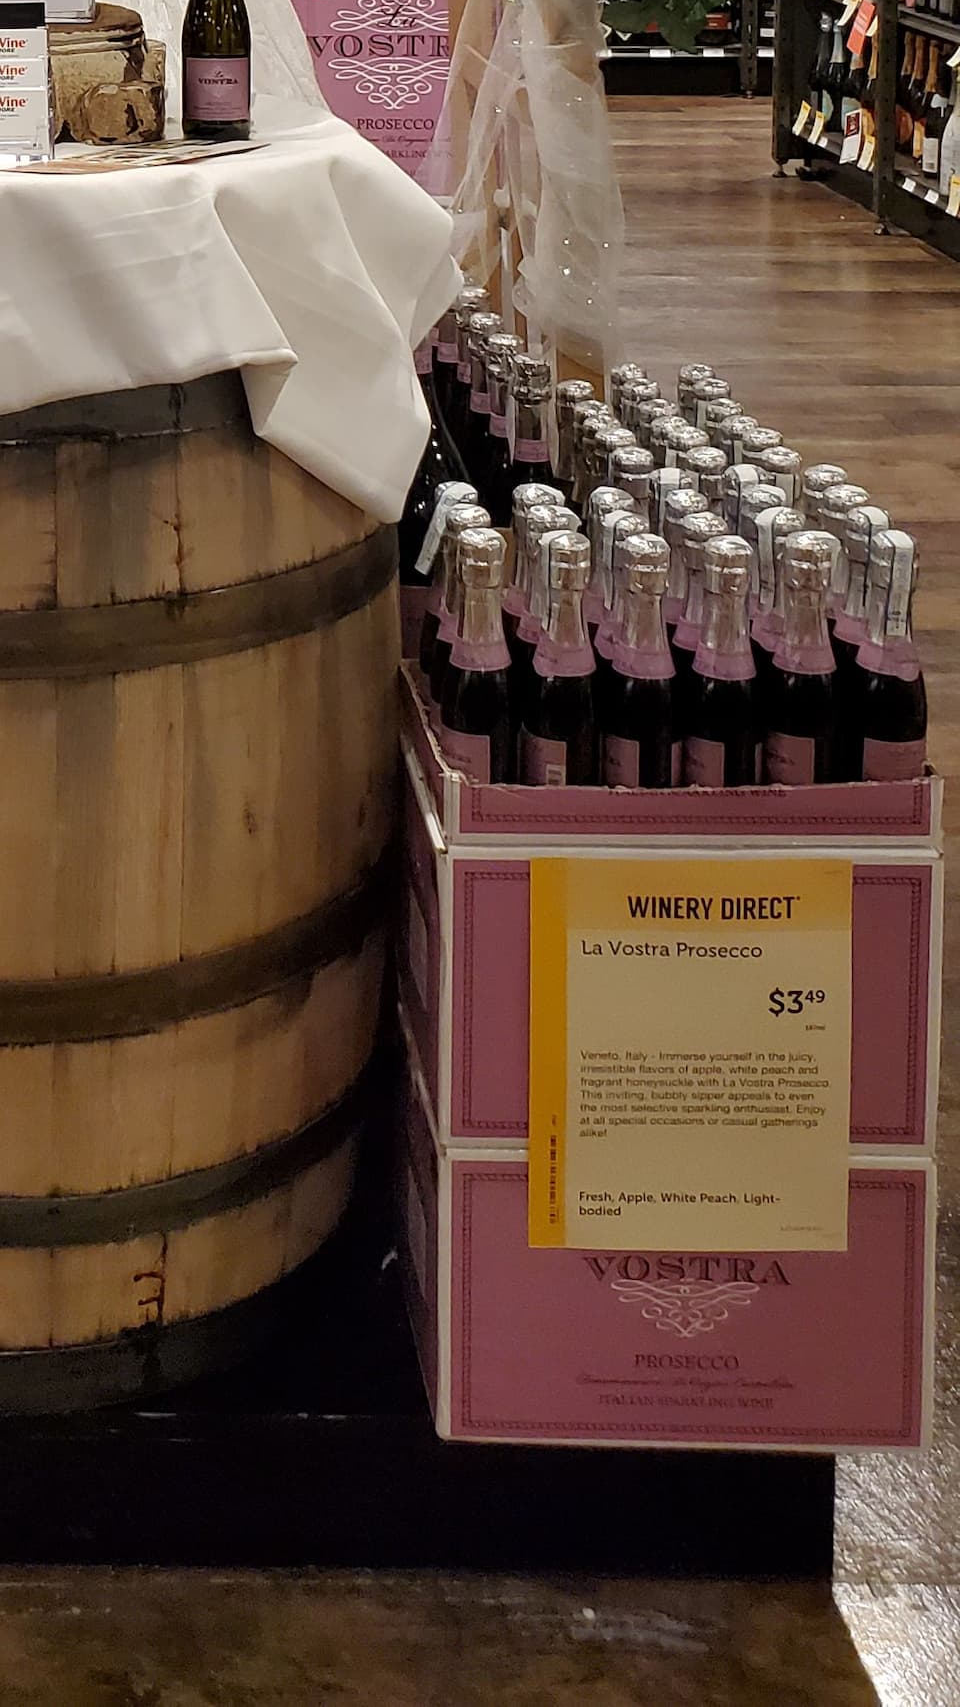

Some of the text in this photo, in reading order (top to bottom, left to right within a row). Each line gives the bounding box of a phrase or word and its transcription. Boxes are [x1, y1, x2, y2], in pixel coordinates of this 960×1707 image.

[377, 5, 417, 28] La
[307, 34, 449, 58] VOSTR
[357, 118, 434, 130] PROSECCO
[627, 896, 795, 920] WINERY DIRECT
[581, 940, 763, 958] La Vostra Prosecco
[626, 1051, 648, 1062] Italy
[659, 1051, 706, 1061] Immerse
[709, 1052, 752, 1062] yourself
[756, 1053, 765, 1061] in
[768, 1052, 785, 1061] the
[639, 1065, 674, 1074] flavors
[678, 1065, 688, 1073] of
[729, 1066, 758, 1074] white
[761, 1066, 794, 1075] peach
[798, 1066, 818, 1074] and
[581, 1078, 774, 1088] fragrant honeysuckle with La Vostra
[581, 1090, 602, 1099] This
[651, 1091, 687, 1100] bubbly
[691, 1092, 724, 1101] sipper
[728, 1092, 771, 1101] appeals
[774, 1092, 785, 1100] to
[580, 1103, 597, 1112] the
[600, 1104, 627, 1112] most
[631, 1104, 678, 1112] selective
[681, 1105, 730, 1114] sparkling
[796, 1105, 825, 1115] Enjoy
[593, 1117, 605, 1125] all
[608, 1117, 646, 1126] special
[761, 1118, 818, 1129] gatherings
[579, 1191, 781, 1205] Fresh, Apple, White Peach, Light-
[579, 1205, 621, 1216] bodied
[581, 1255, 791, 1286] VOSTRA
[634, 1354, 740, 1370] PROSECCO
